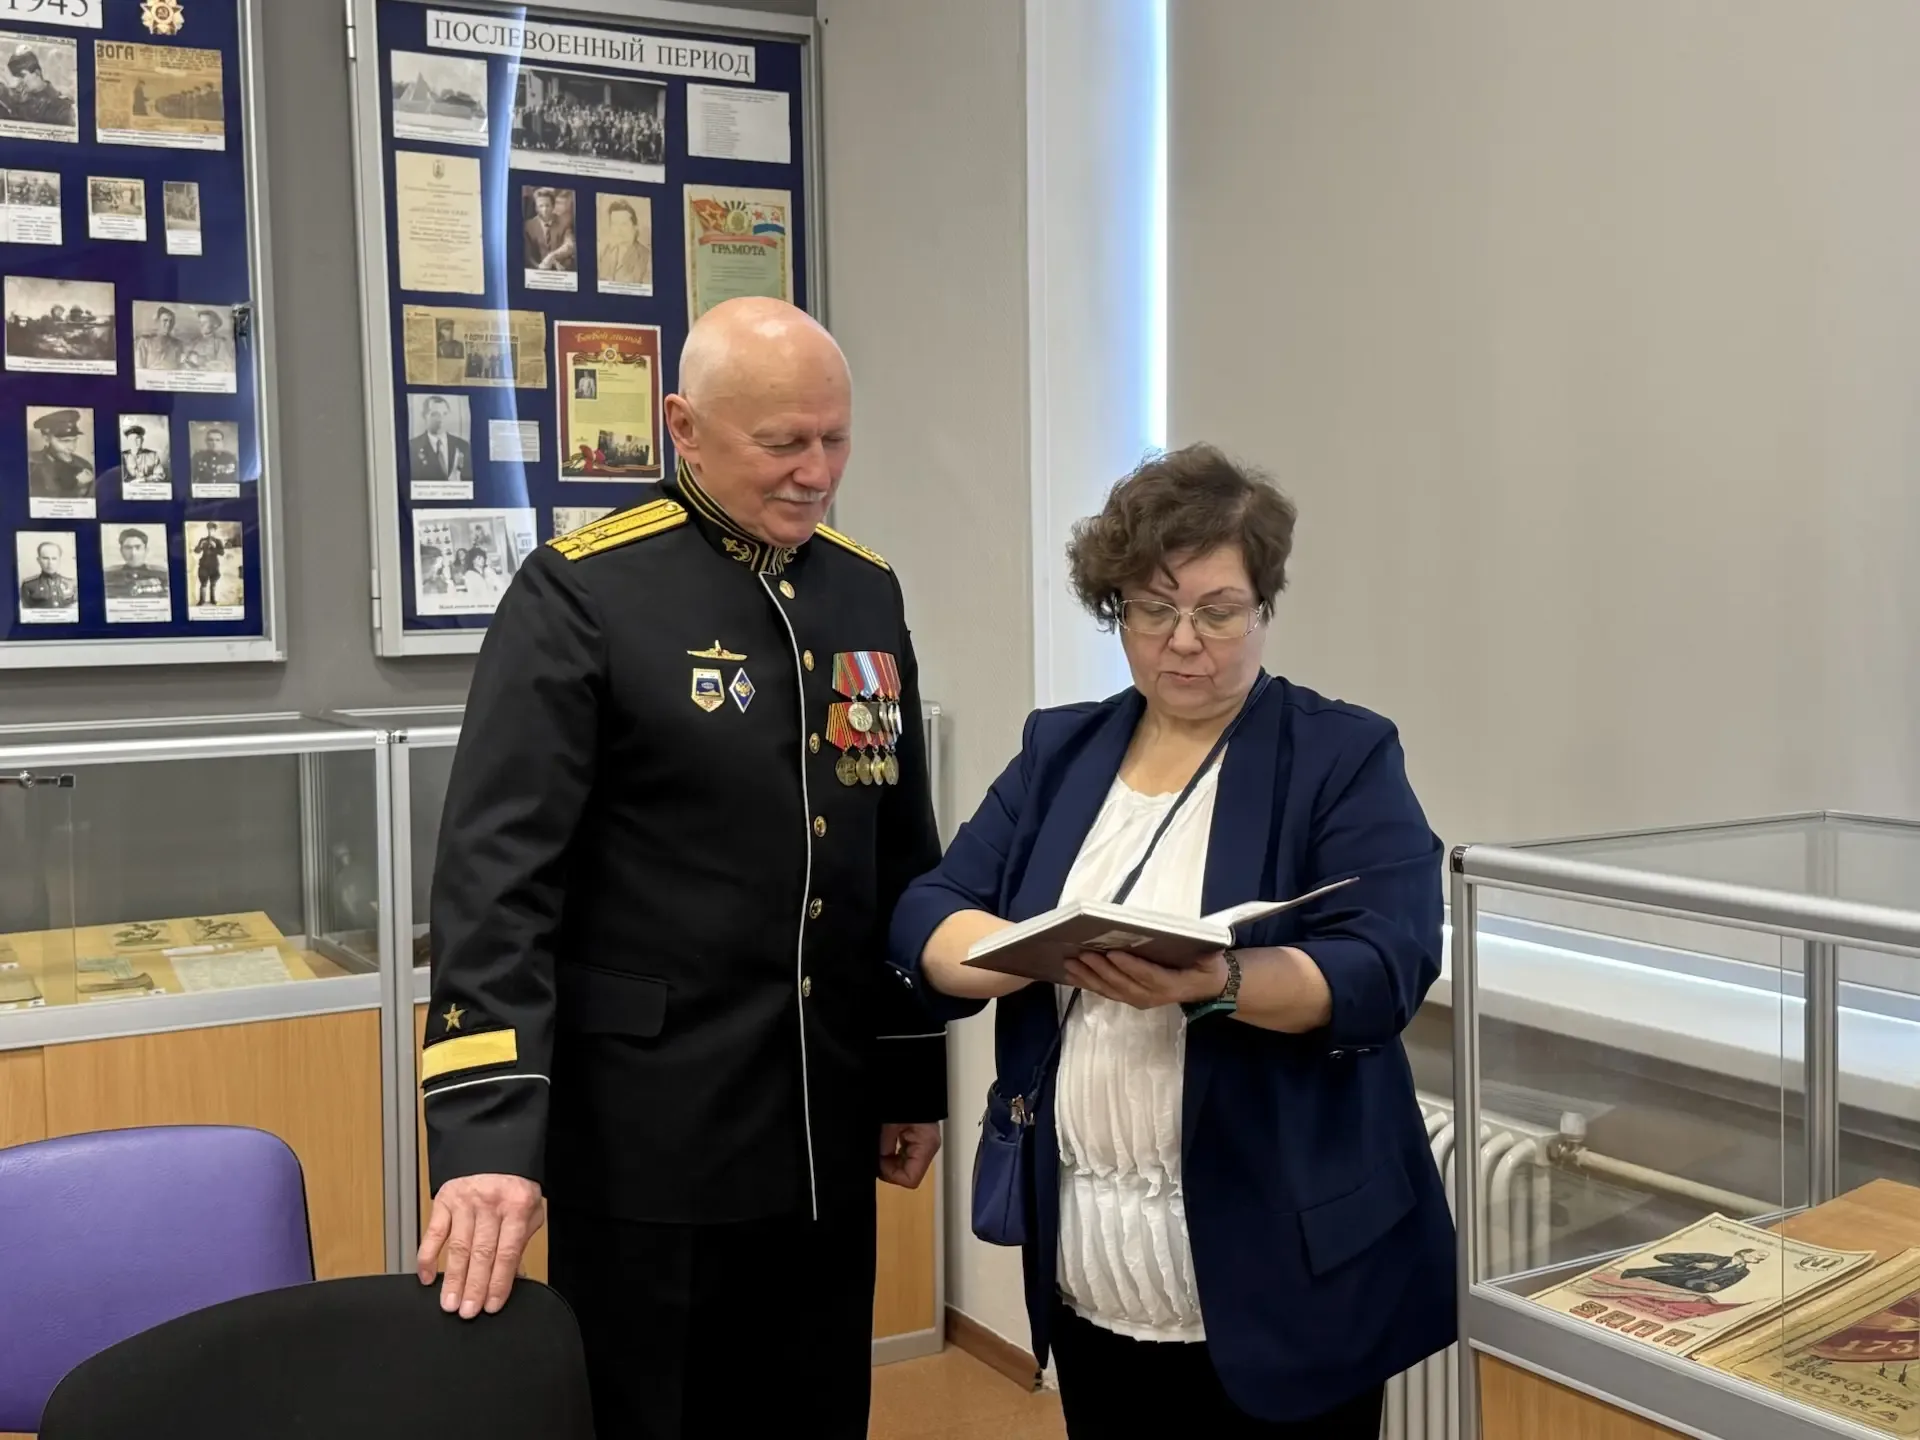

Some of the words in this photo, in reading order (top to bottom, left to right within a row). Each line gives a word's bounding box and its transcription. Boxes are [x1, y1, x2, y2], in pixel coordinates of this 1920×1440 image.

[434, 18, 644, 63] ПОСЛЕВОЕННЫЙ
[657, 44, 750, 77] ПЕРИОД
[711, 243, 767, 256] ГРАМОТА
